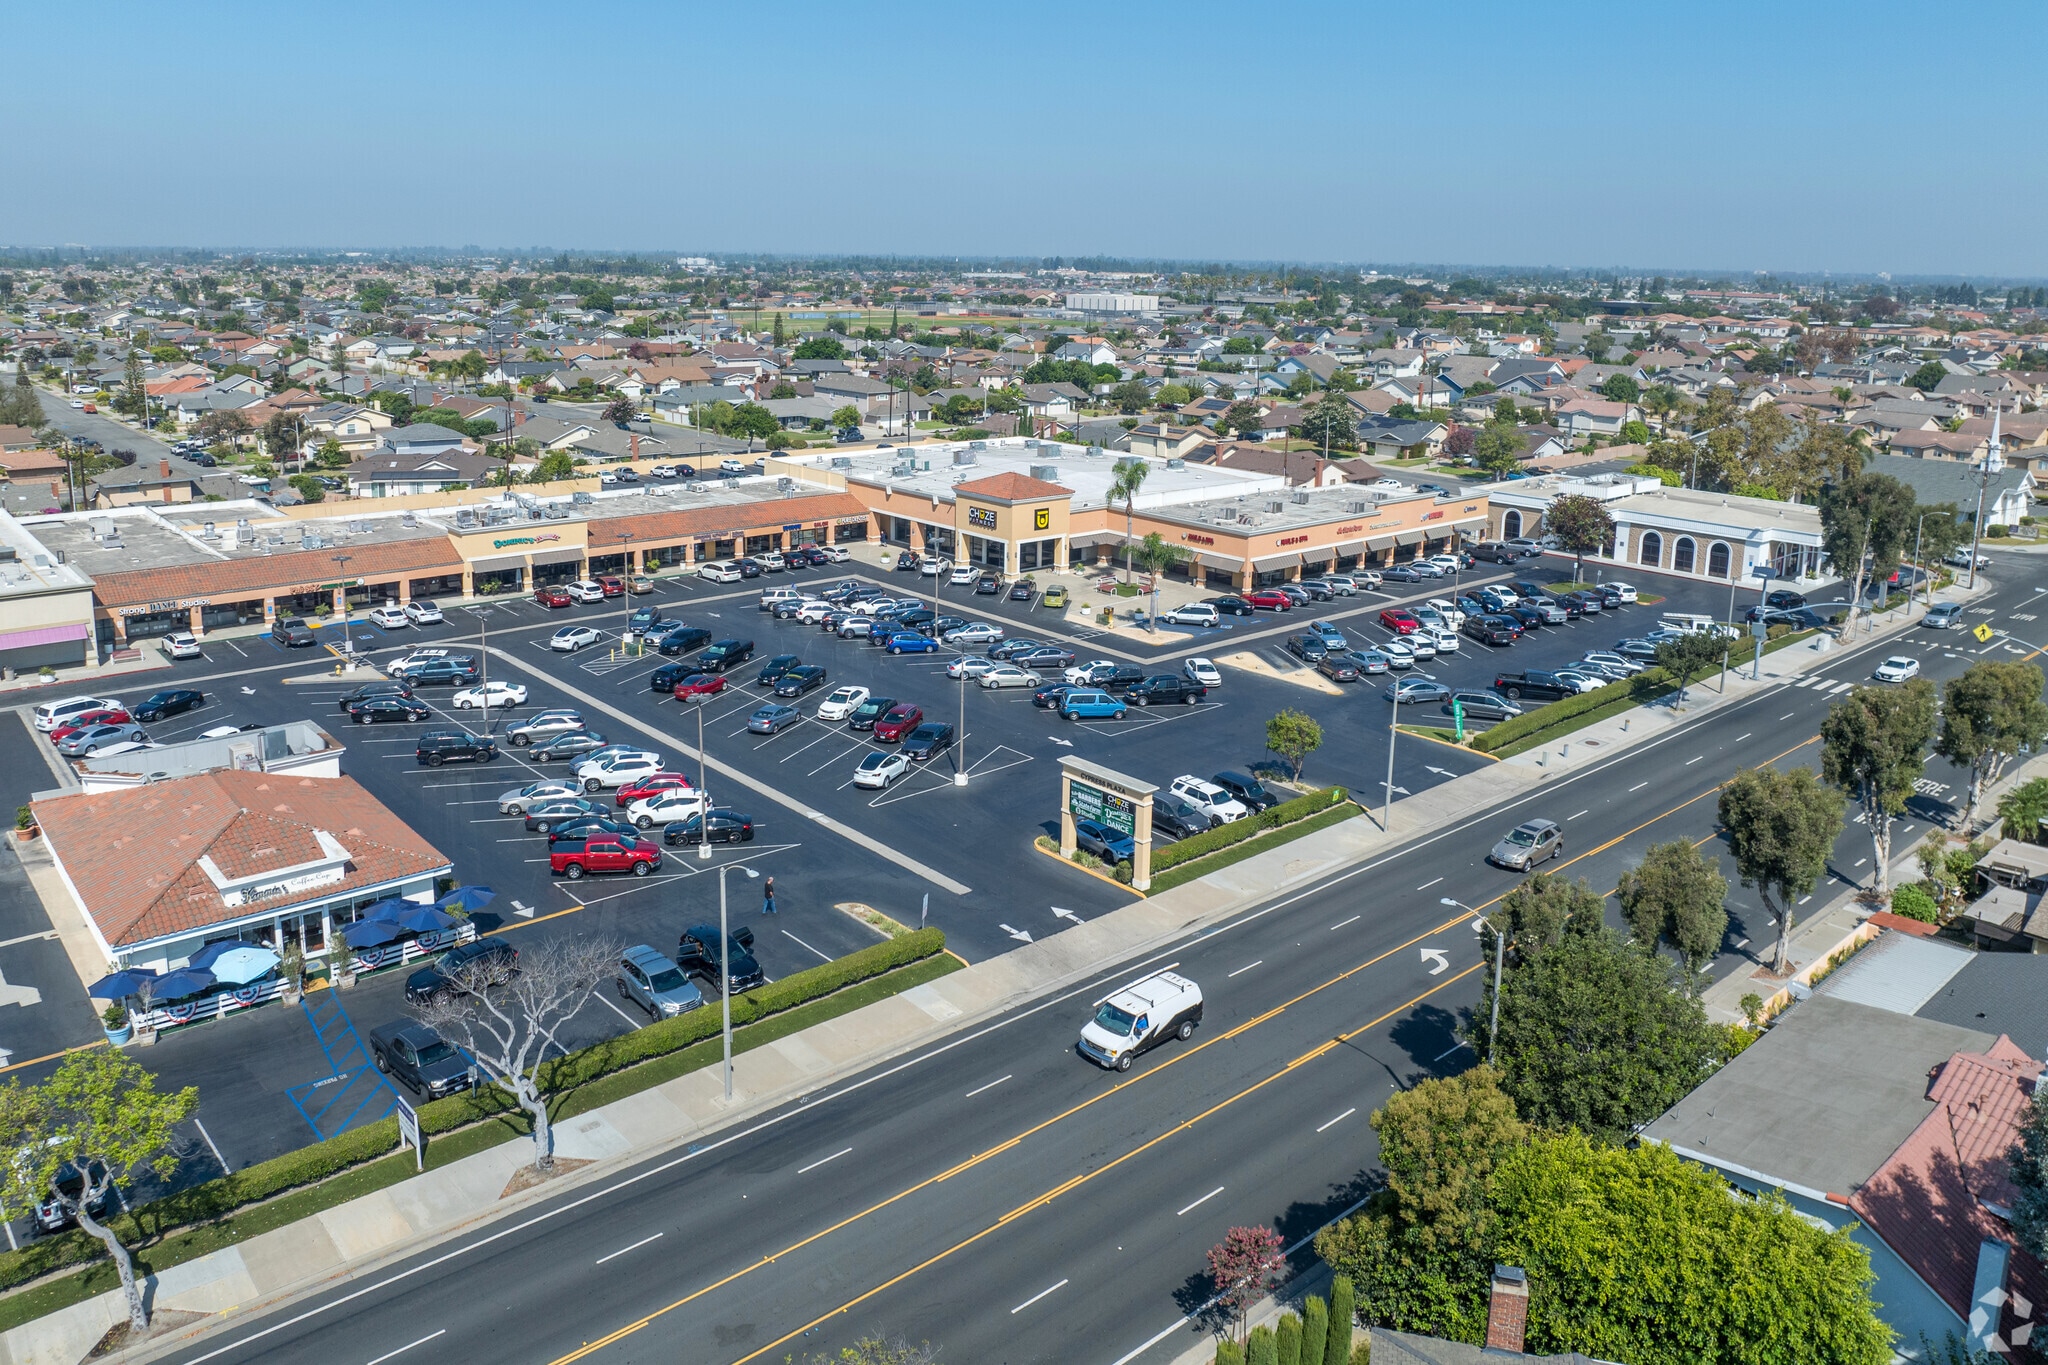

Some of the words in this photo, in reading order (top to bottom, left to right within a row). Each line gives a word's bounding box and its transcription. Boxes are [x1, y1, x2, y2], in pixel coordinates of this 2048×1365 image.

[969, 508, 994, 522] CHUZE
[969, 517, 994, 527] FITNESS
[119, 607, 146, 616] Strong
[181, 599, 211, 608] Studios
[1081, 773, 1106, 787] CYPRESS
[1106, 783, 1126, 794] PLAZA
[1107, 795, 1129, 808] CHUZE
[1106, 820, 1129, 834] DANCE
[290, 876, 315, 888] Coffee
[315, 872, 331, 882] Cup
[313, 1077, 338, 1088] PARKING
